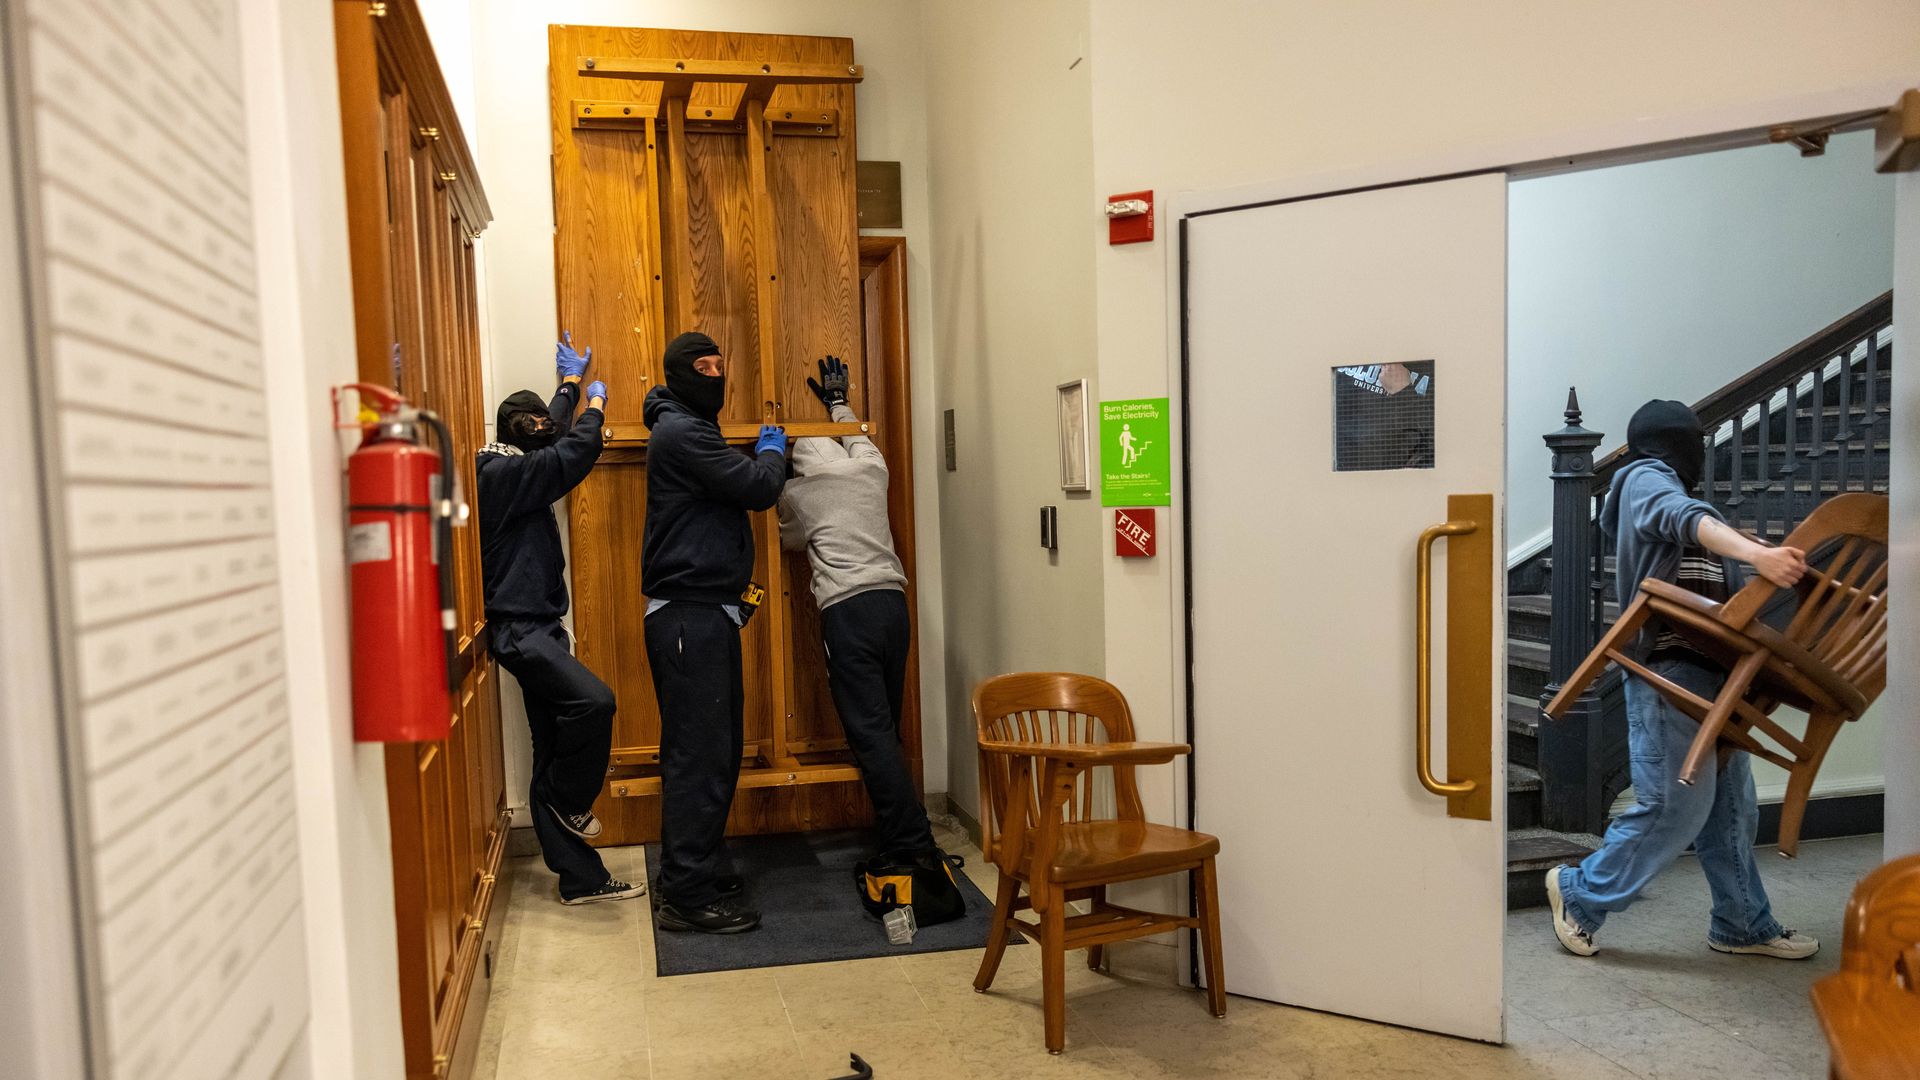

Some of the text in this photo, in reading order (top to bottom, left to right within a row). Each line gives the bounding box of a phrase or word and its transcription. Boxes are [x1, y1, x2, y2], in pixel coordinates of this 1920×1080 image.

[1104, 405, 1121, 413] Burn
[1122, 410, 1159, 419] Electricity
[1117, 515, 1151, 545] FIRE
